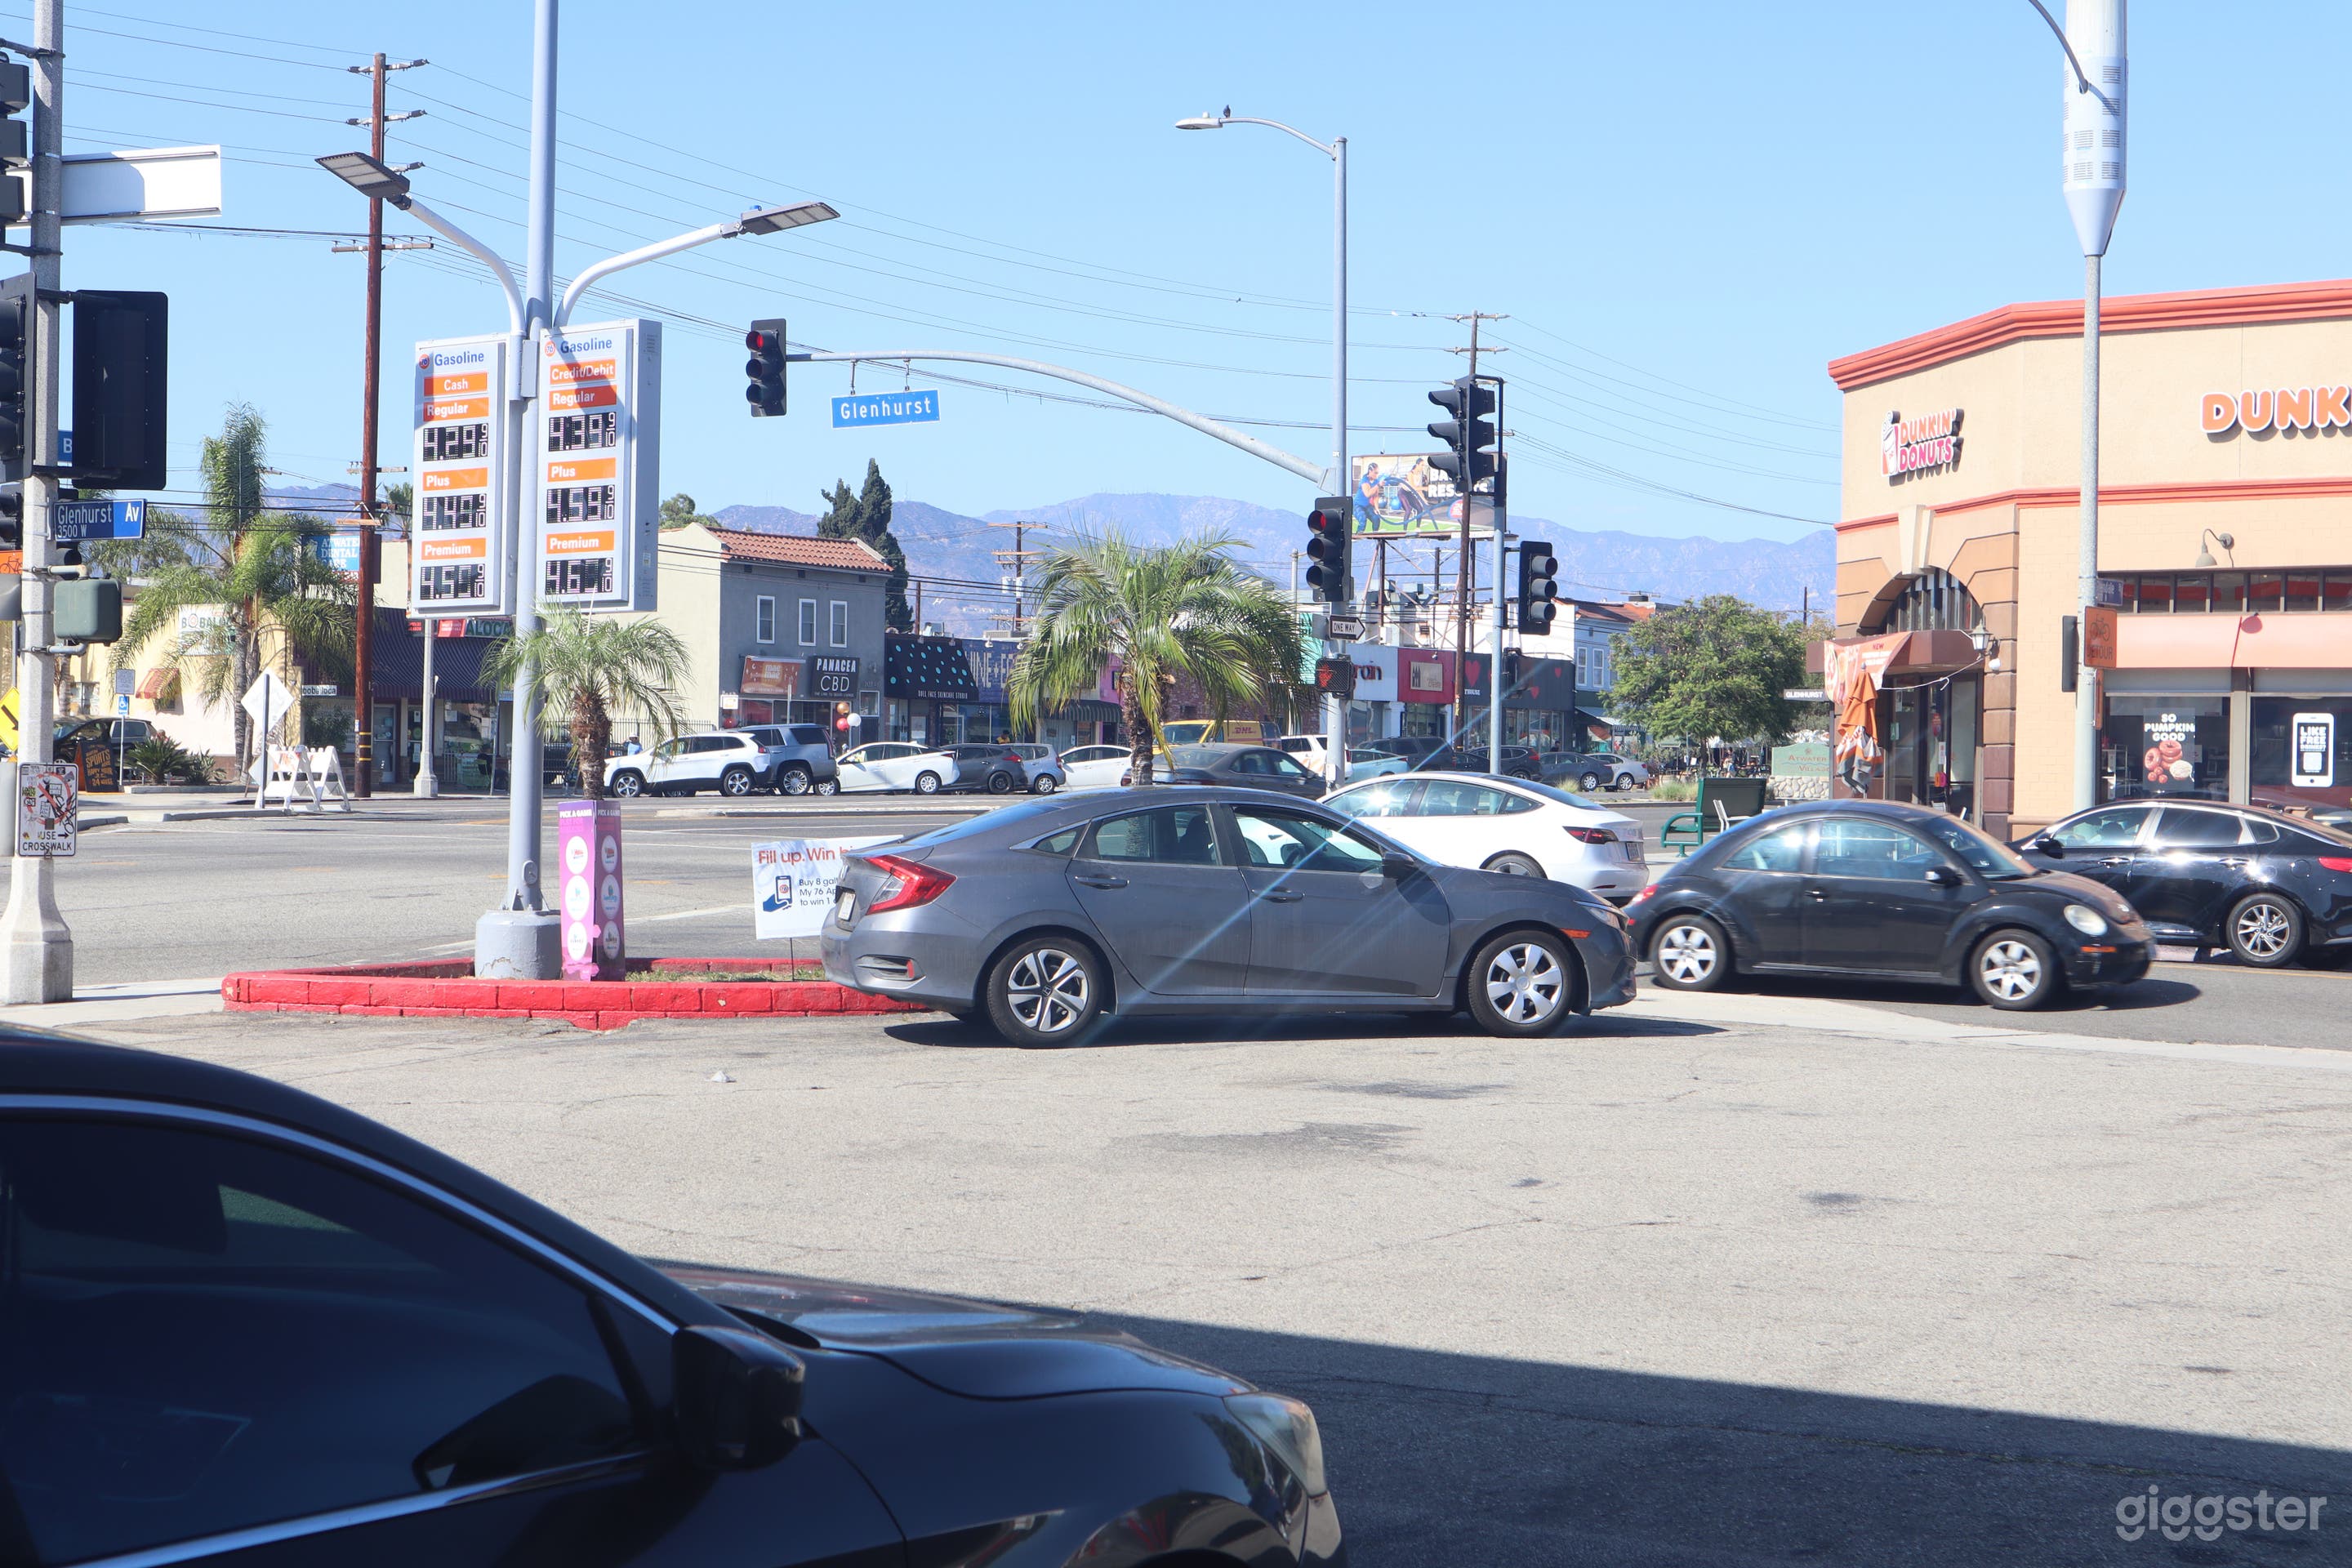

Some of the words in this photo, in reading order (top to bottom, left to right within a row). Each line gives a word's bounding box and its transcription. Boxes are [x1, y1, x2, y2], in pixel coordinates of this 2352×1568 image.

[560, 338, 612, 354] Gasoline
[434, 351, 484, 366] Gasoline
[552, 363, 614, 381] Credit/Debit
[444, 378, 469, 390] Cash
[553, 391, 595, 406] Regular
[427, 403, 469, 417] Regular
[840, 397, 932, 419] Glenhurst
[2201, 385, 2352, 433] DUNK
[1900, 409, 1956, 446] DUNKIN'
[63, 438, 73, 454] B
[1899, 437, 1953, 472] DONUTS
[551, 466, 576, 479] Plus
[426, 475, 450, 488] Plus
[58, 504, 112, 524] Glenhurst
[125, 502, 140, 523] Av
[58, 524, 78, 538] 3500
[81, 524, 87, 537] W
[321, 537, 360, 547] ATWATE
[550, 537, 599, 550] Premium
[321, 548, 358, 558] DENTAL
[425, 543, 471, 556] Premium
[1334, 623, 1343, 632] ONE
[1345, 623, 1356, 633] WAY
[817, 658, 856, 672] PANACEA
[820, 675, 850, 692] CBD
[2161, 713, 2177, 723] SO
[2152, 732, 2186, 742] GOOD
[2300, 726, 2327, 736] LIKE
[2300, 736, 2327, 745] FREE
[40, 831, 56, 840] USE
[22, 842, 72, 851] CROSSWALK
[758, 850, 777, 863] Fill
[781, 852, 805, 866] up.
[805, 847, 835, 862] Win
[799, 878, 814, 887] Buy
[800, 889, 811, 898] My
[811, 898, 825, 906] win
